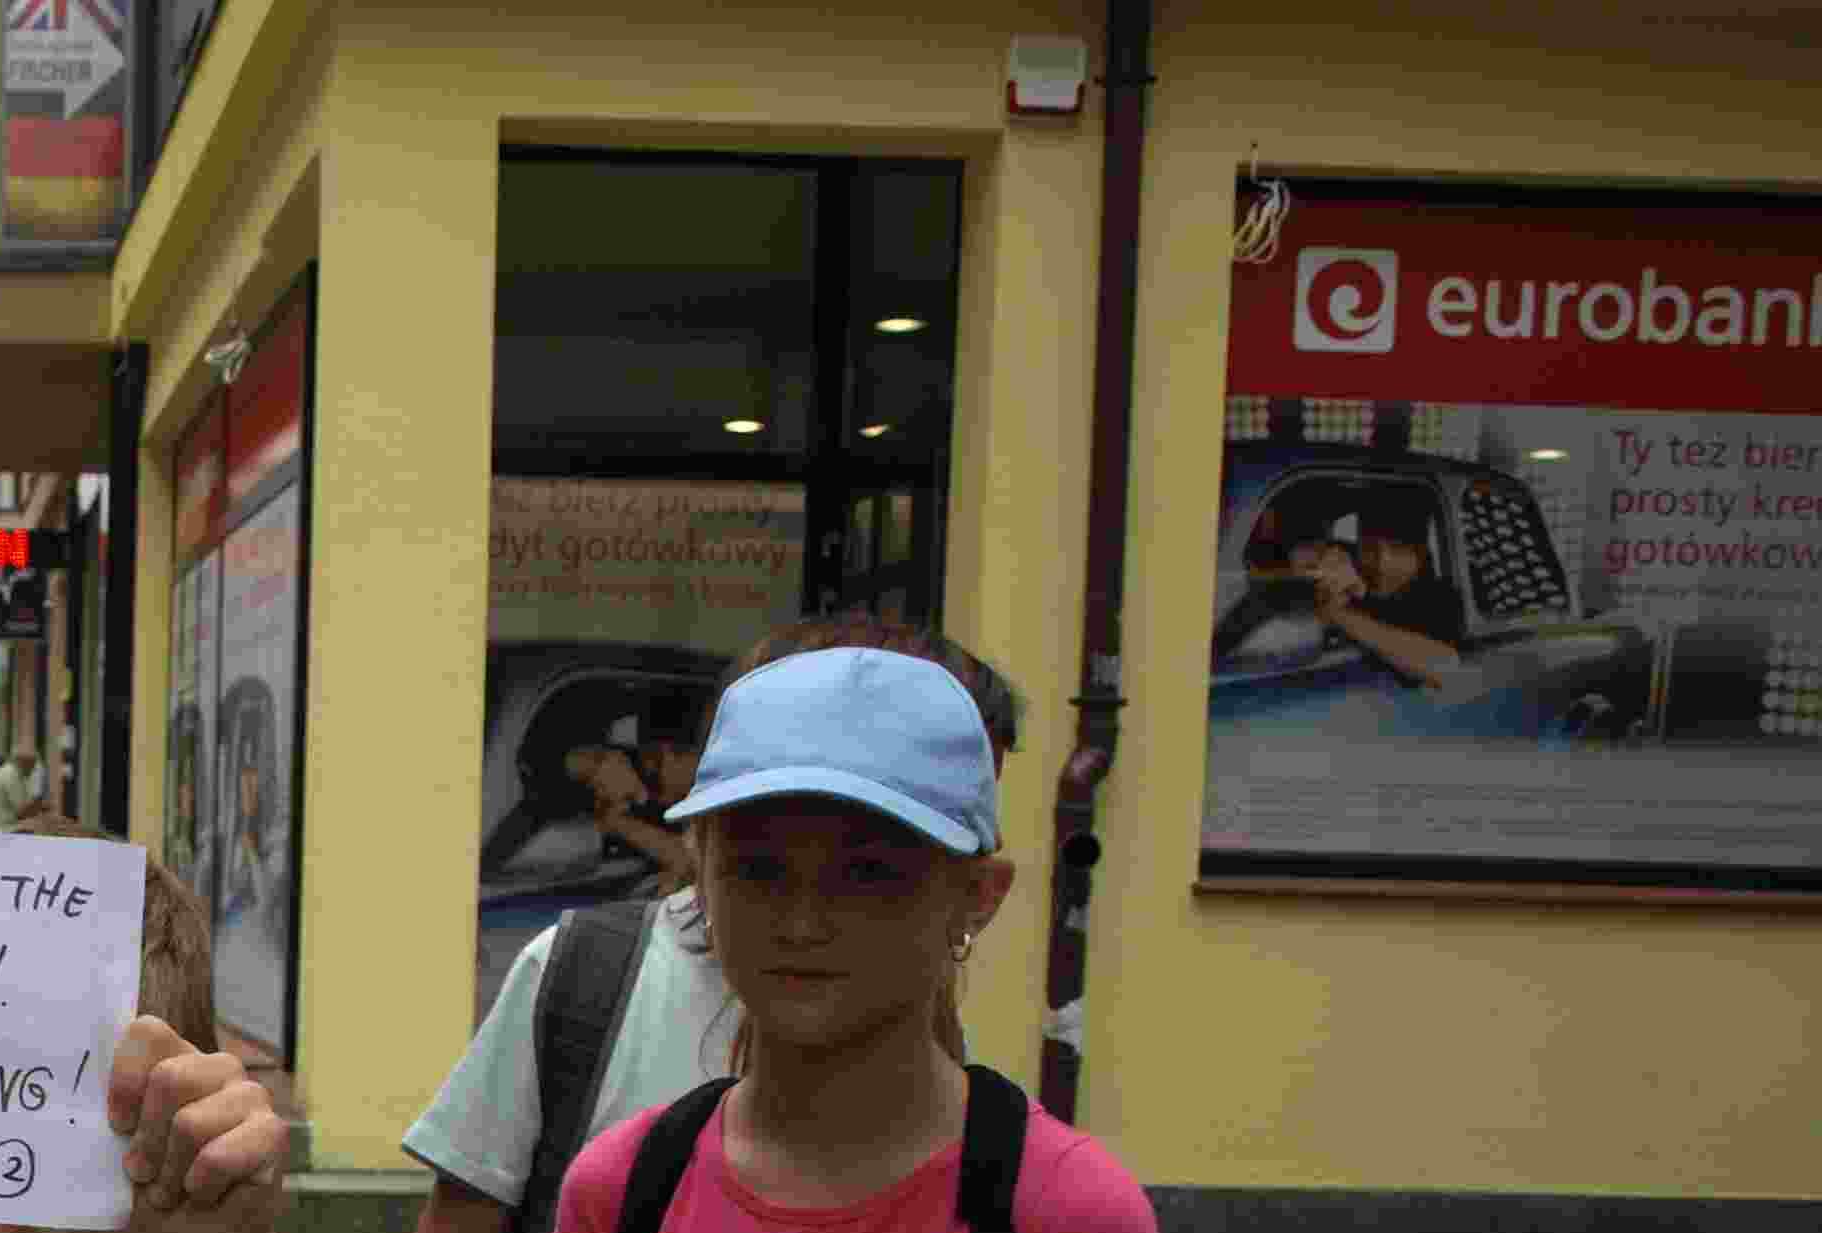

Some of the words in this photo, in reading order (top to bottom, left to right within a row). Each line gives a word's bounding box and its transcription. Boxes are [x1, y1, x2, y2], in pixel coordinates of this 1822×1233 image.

[1612, 428, 1655, 476] Ty
[1666, 431, 1728, 470] też
[1610, 486, 1738, 527] prosty
[0, 871, 95, 918] THE
